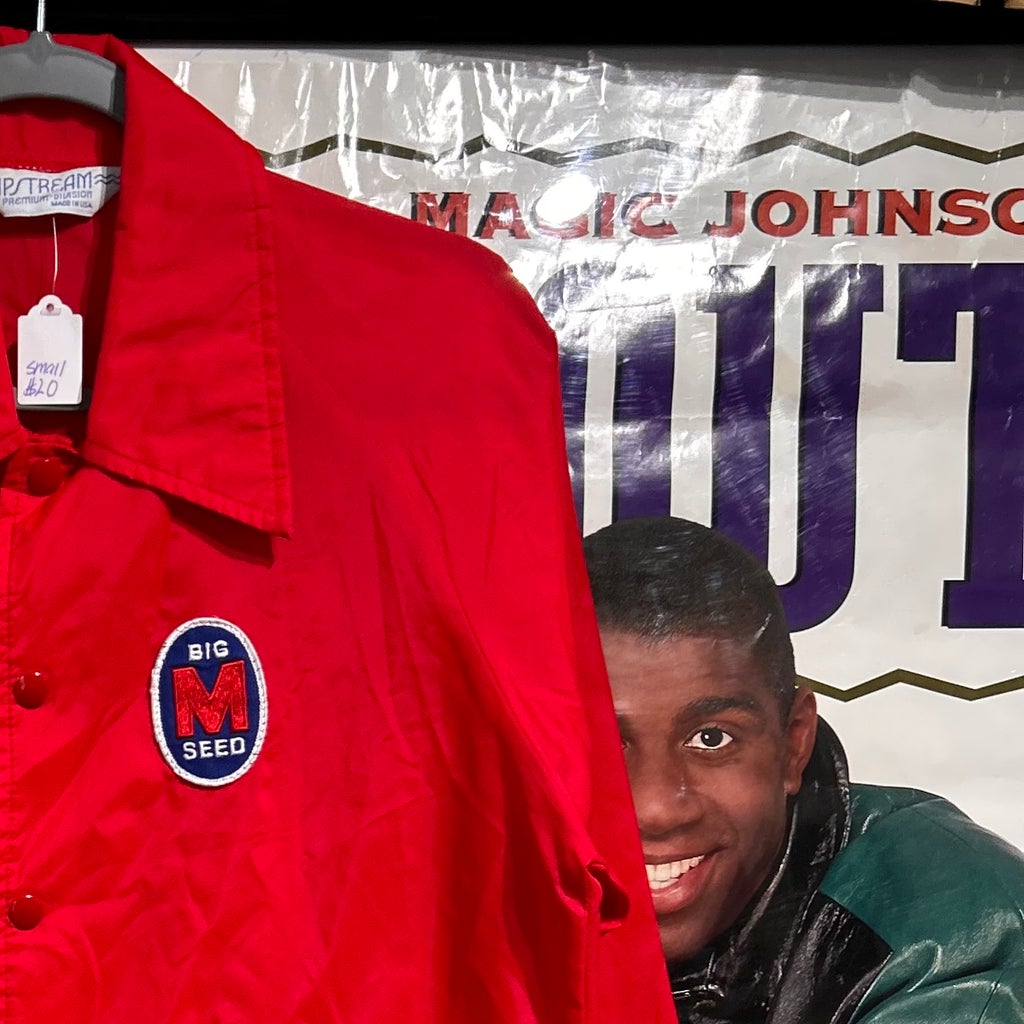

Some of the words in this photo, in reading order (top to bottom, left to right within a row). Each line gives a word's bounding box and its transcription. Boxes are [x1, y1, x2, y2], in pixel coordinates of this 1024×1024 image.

[2, 194, 49, 206] PREMIUM
[53, 190, 93, 200] DIVISION
[188, 640, 229, 662] BIG
[172, 660, 249, 738] M
[183, 737, 246, 760] SEED
